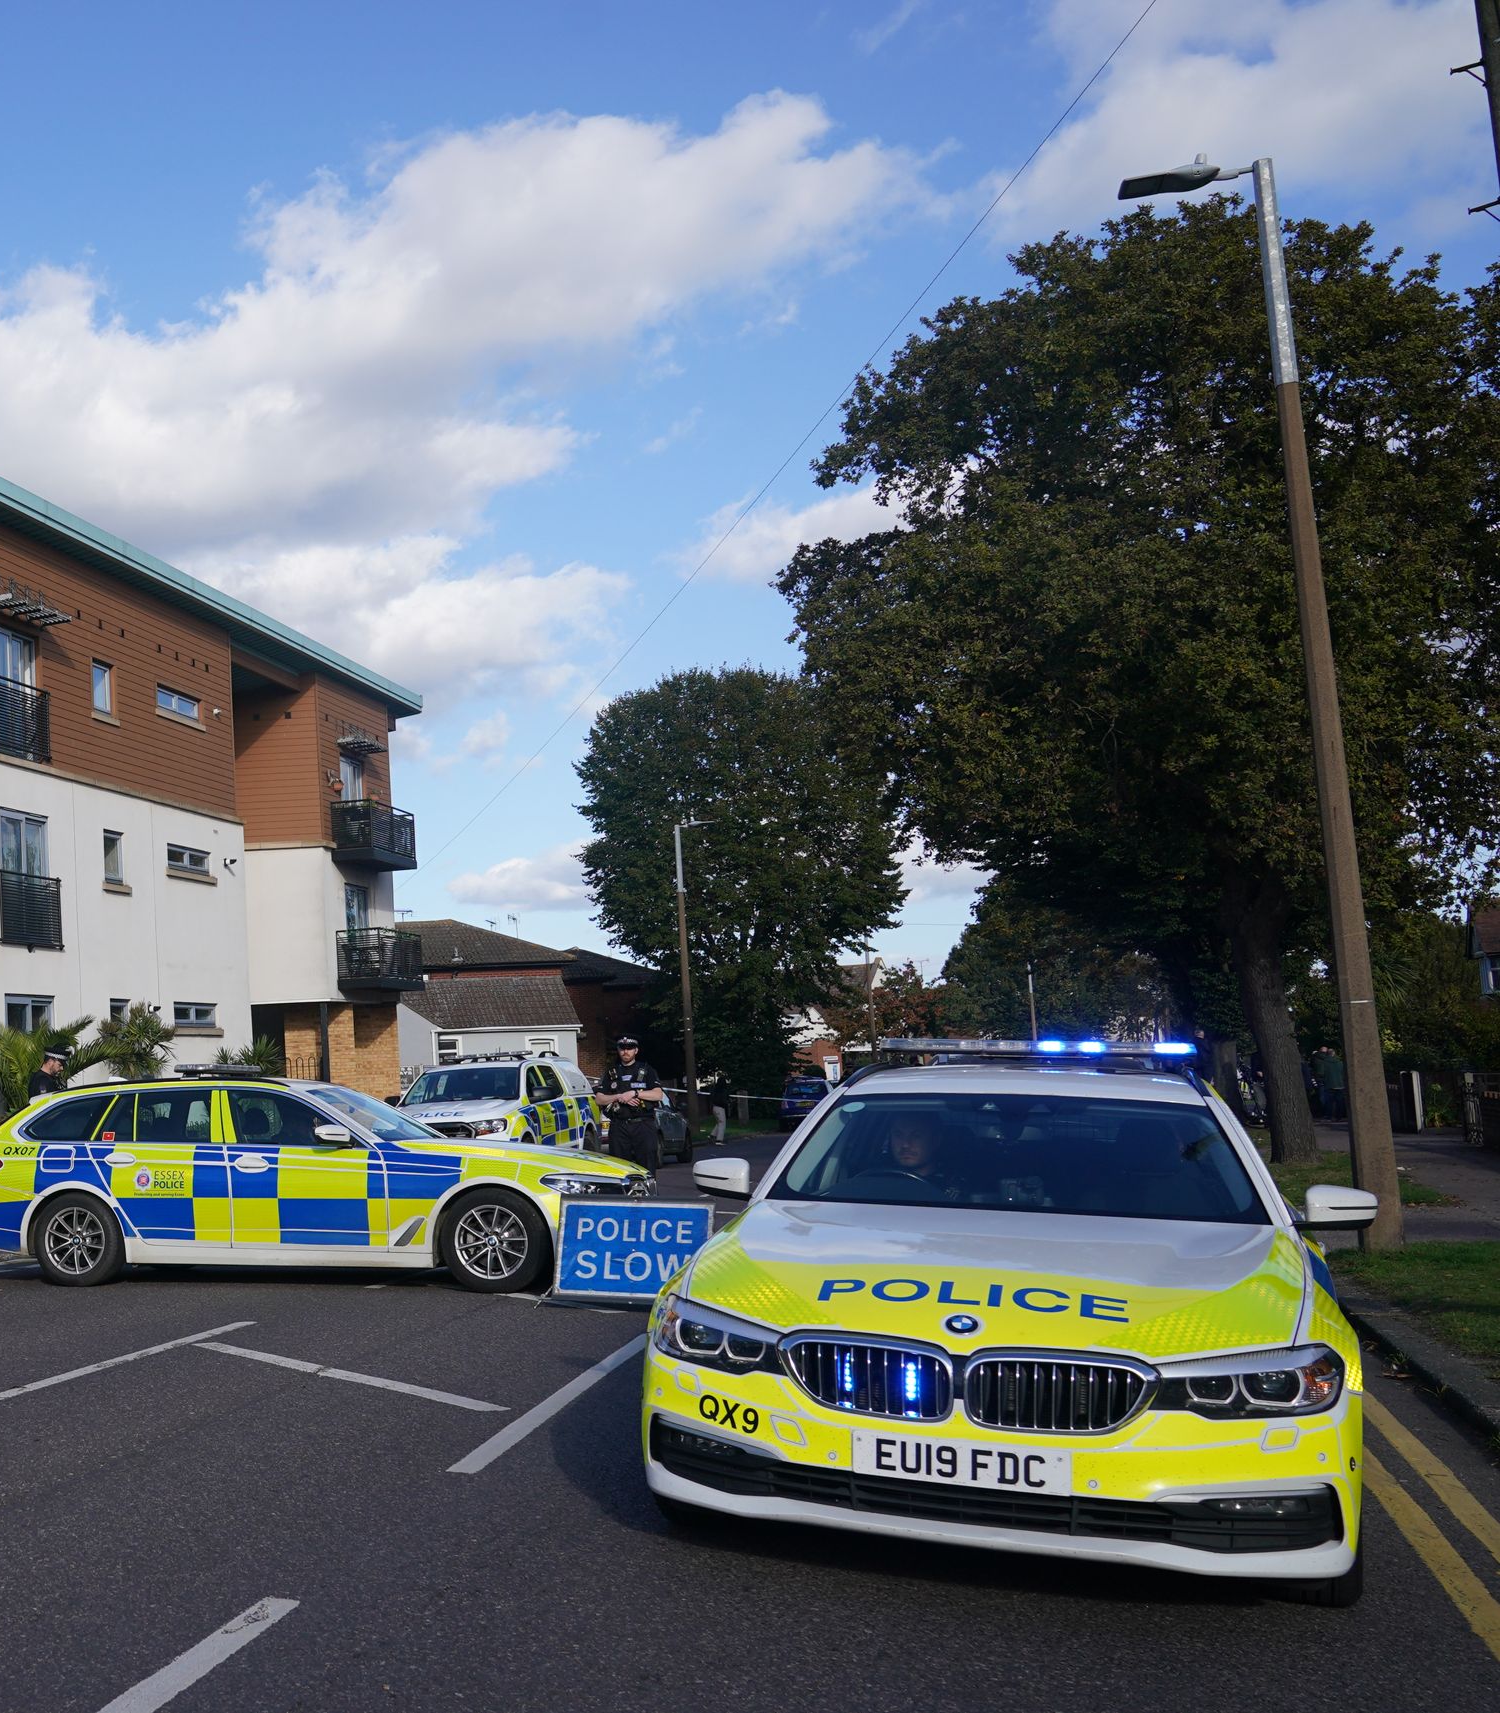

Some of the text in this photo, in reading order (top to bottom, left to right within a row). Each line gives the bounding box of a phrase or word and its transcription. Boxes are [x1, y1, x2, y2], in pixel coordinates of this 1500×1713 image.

[3, 1146, 36, 1156] QX07
[154, 1170, 185, 1180] ESSEX
[154, 1180, 185, 1189] POLICE
[576, 1217, 694, 1244] POLICE
[817, 1278, 1130, 1323] POLICE
[699, 1394, 759, 1434] QX9
[875, 1437, 1047, 1488] EU19 FDC
